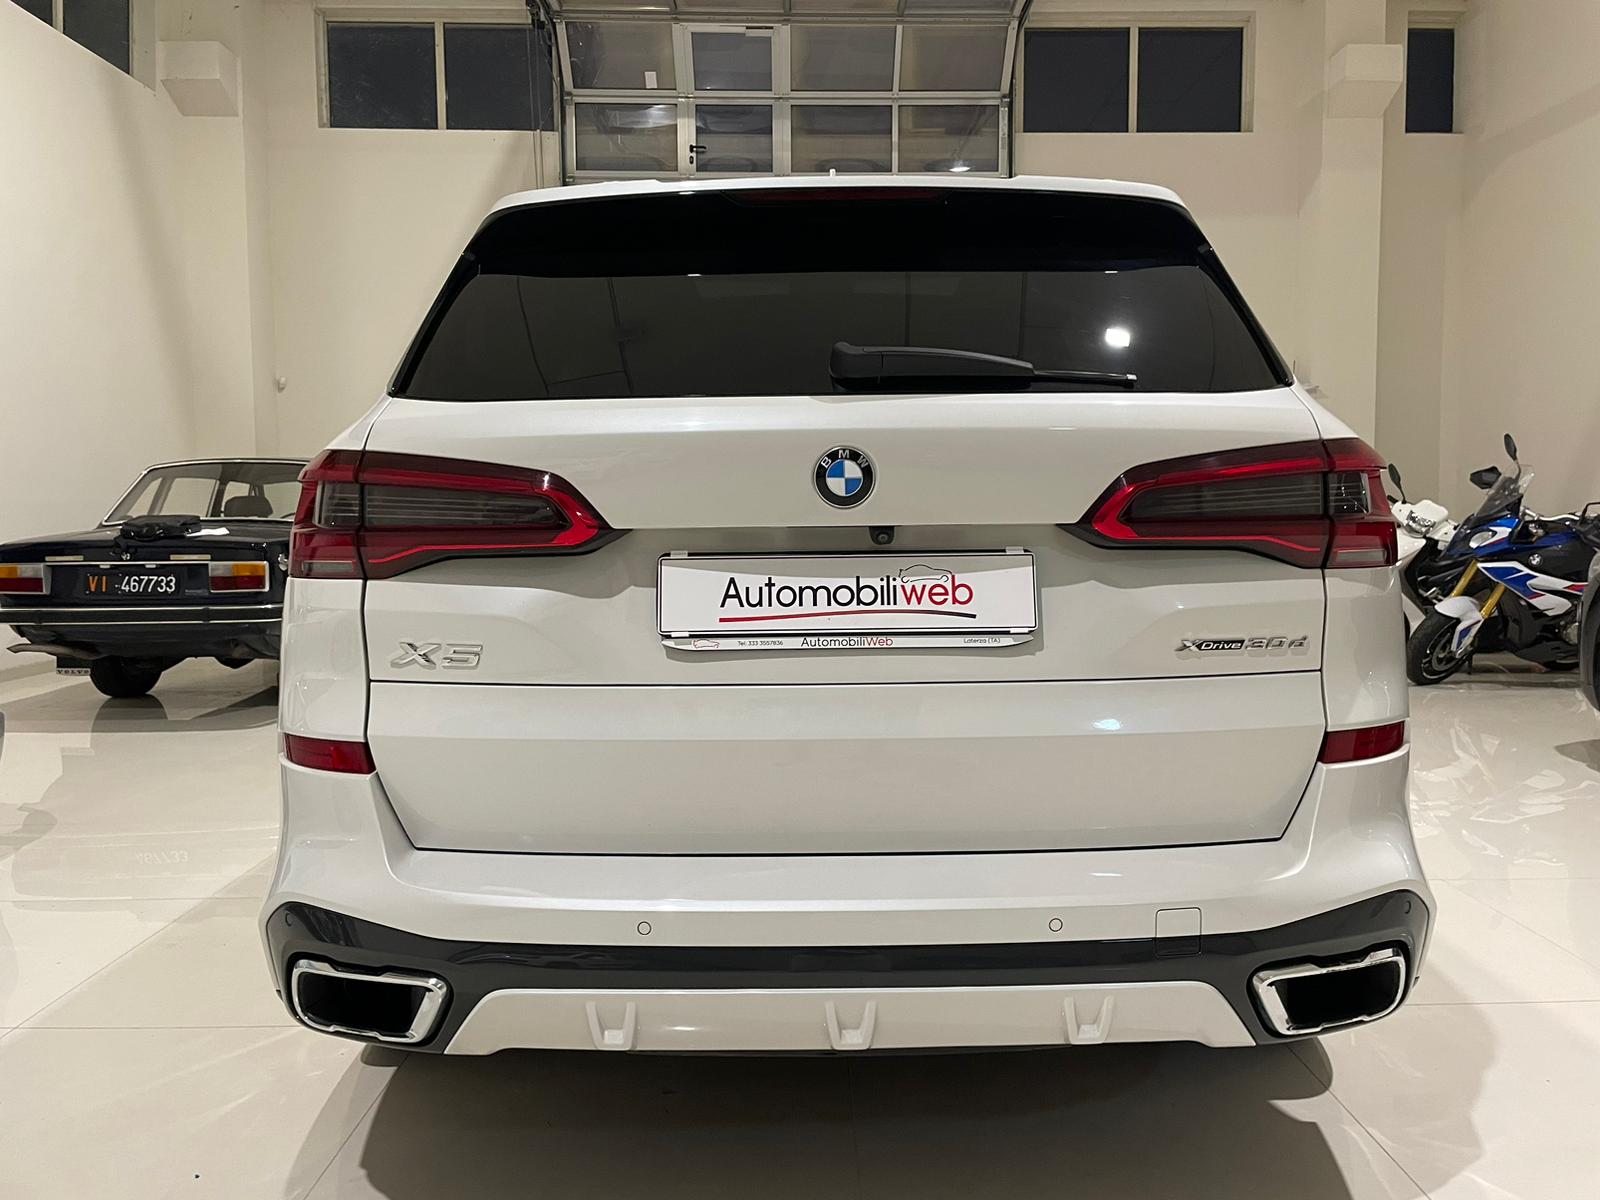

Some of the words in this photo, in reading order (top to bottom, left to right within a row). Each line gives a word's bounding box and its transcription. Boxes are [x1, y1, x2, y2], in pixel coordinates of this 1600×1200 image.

[821, 449, 869, 468] BMW
[89, 575, 107, 592] VI
[121, 576, 176, 592] 467733
[720, 574, 974, 608] Automobiliweb
[801, 637, 894, 647] AutomobiliWeb
[390, 641, 483, 669] X5
